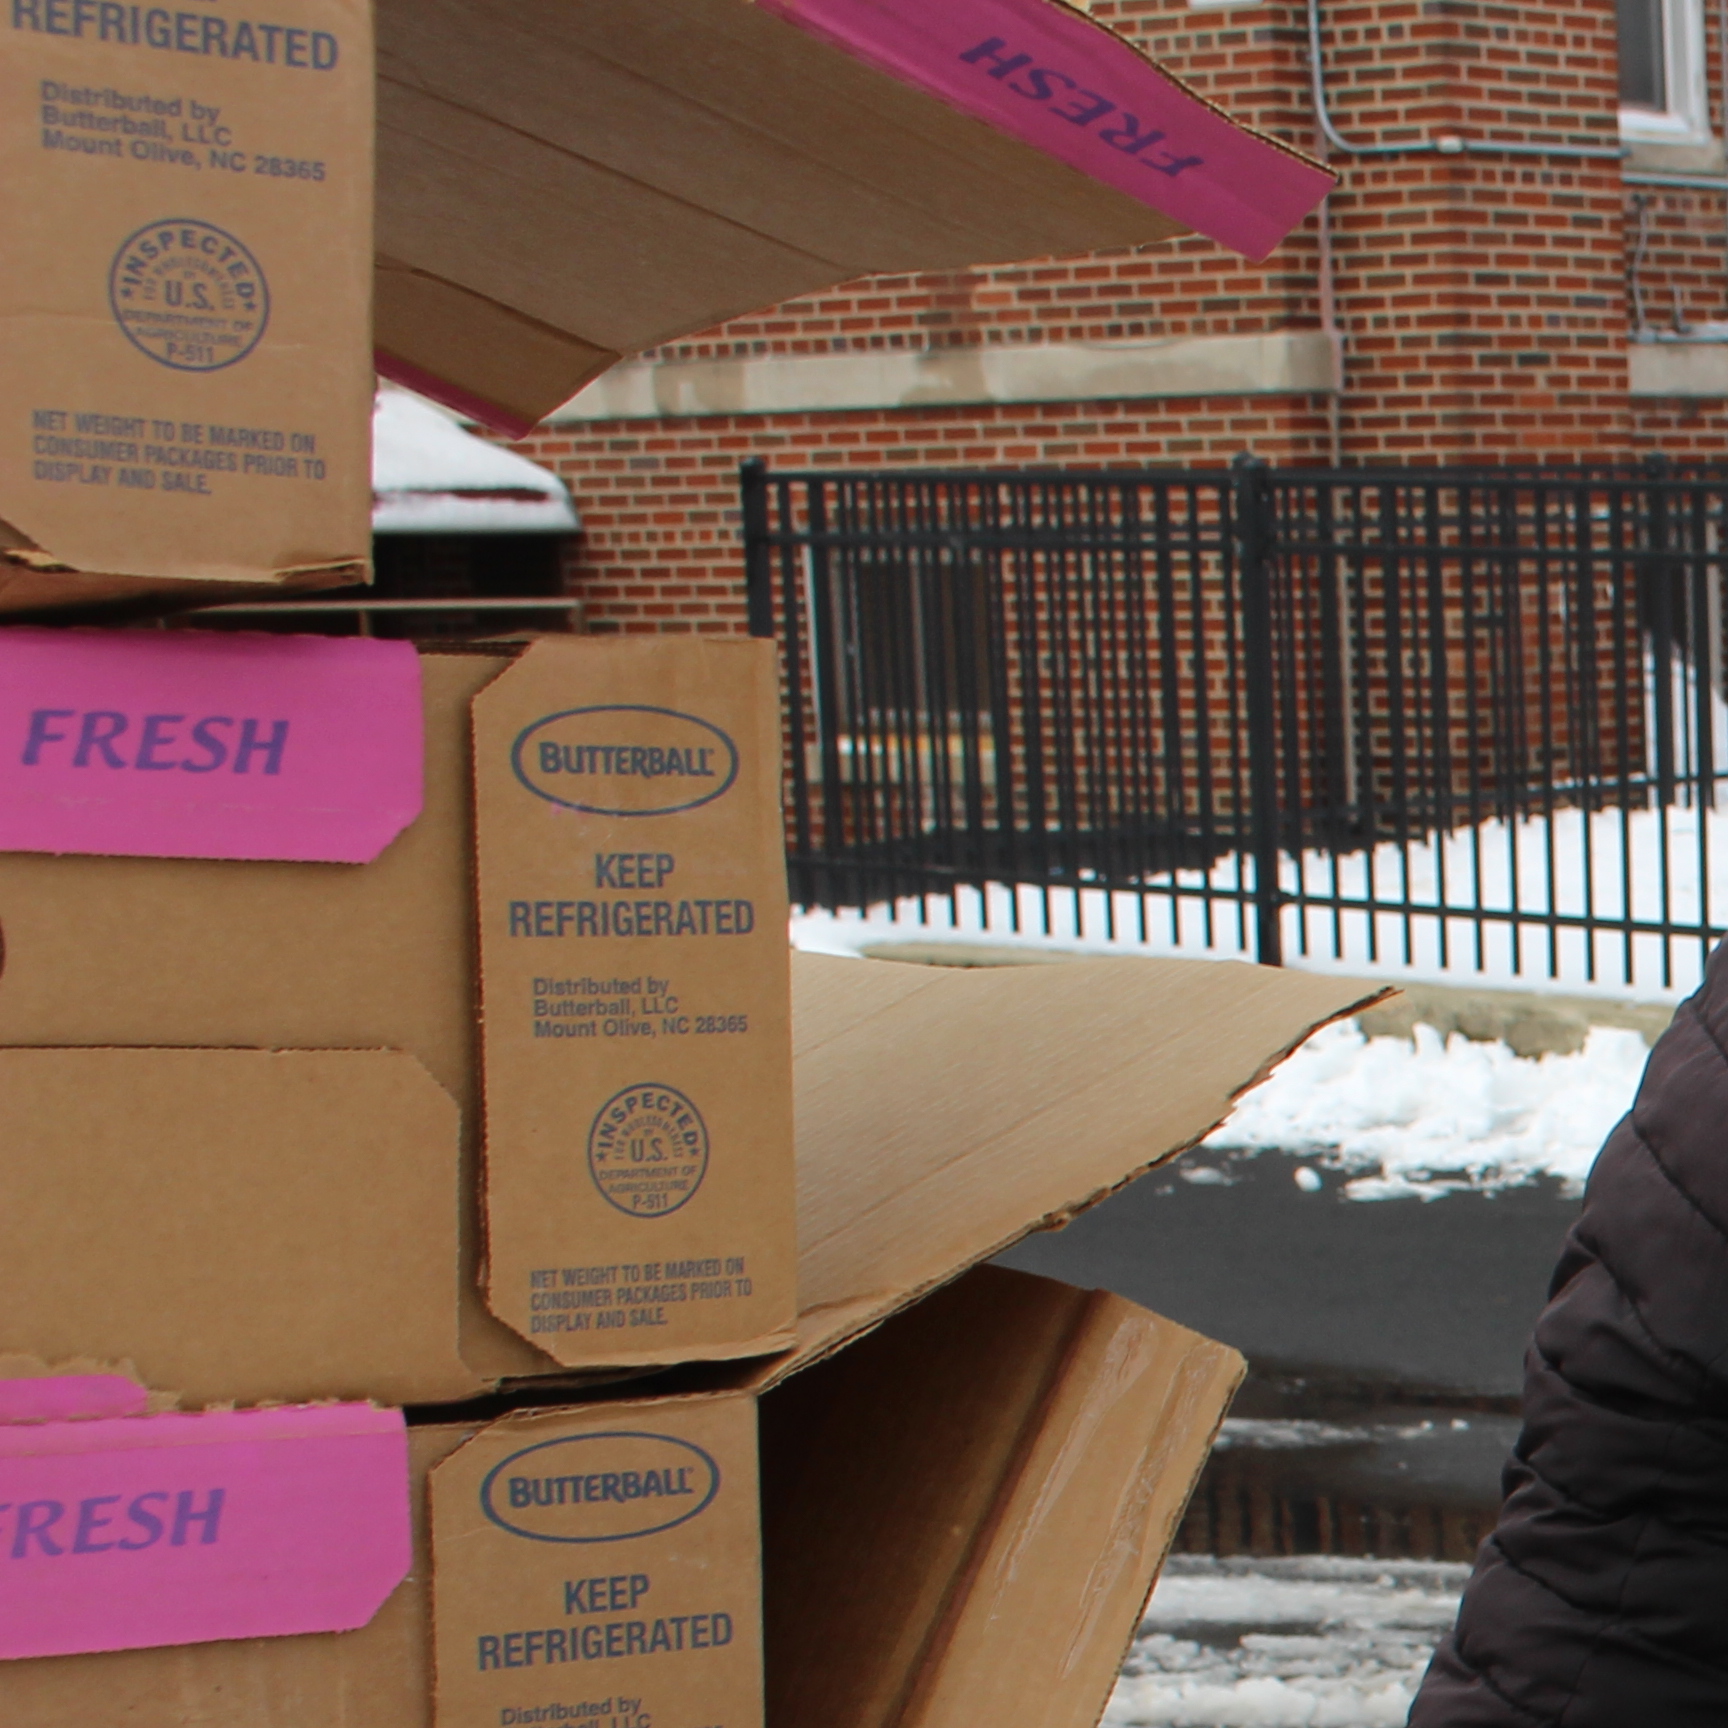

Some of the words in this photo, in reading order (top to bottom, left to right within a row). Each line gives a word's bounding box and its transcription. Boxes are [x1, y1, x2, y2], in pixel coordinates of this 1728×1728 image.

[12, 0, 338, 70] REFRIGERATED
[40, 79, 182, 117] Distributed
[190, 99, 221, 126] by
[958, 36, 1204, 177] FRESH
[42, 128, 123, 157] Mount
[131, 139, 201, 170] Olive,
[210, 150, 246, 172] NC
[182, 122, 232, 147] LLC
[123, 229, 255, 298] INSPECTED
[21, 709, 289, 775] FRESH
[539, 741, 715, 778] BUTTERBALL
[595, 853, 675, 889] KEEP
[509, 899, 755, 938] REFRIGERATED
[533, 977, 642, 996] Distributed
[647, 976, 670, 997] by
[534, 999, 636, 1017] Butterball,
[641, 996, 679, 1014] LLC
[534, 1019, 597, 1038] Mount
[603, 1018, 657, 1038] Olive,
[661, 1016, 690, 1035] NC
[695, 1014, 748, 1034] 28365
[597, 1091, 698, 1148] INSPECTED
[630, 1137, 668, 1162] U.S.
[530, 1269, 557, 1288] NET
[562, 1266, 618, 1286] WEIGHT
[621, 1264, 640, 1283] TO
[643, 1263, 661, 1282] BE
[664, 1259, 721, 1279] MARKED
[726, 1256, 745, 1276] ON
[530, 1288, 612, 1311] CONSUMER
[616, 1283, 687, 1304] PACKAGES
[690, 1280, 732, 1300] PRIOR
[736, 1278, 753, 1296] TO
[530, 1312, 591, 1334] DISPLAY
[596, 1310, 626, 1330] AND
[508, 1468, 695, 1509] BUTTERBALL
[0, 1489, 225, 1559] RESH
[564, 1573, 650, 1615] KEEP
[477, 1612, 733, 1672] REFRIGERATED
[501, 1697, 612, 1726] Distributed
[618, 1696, 642, 1714] by
